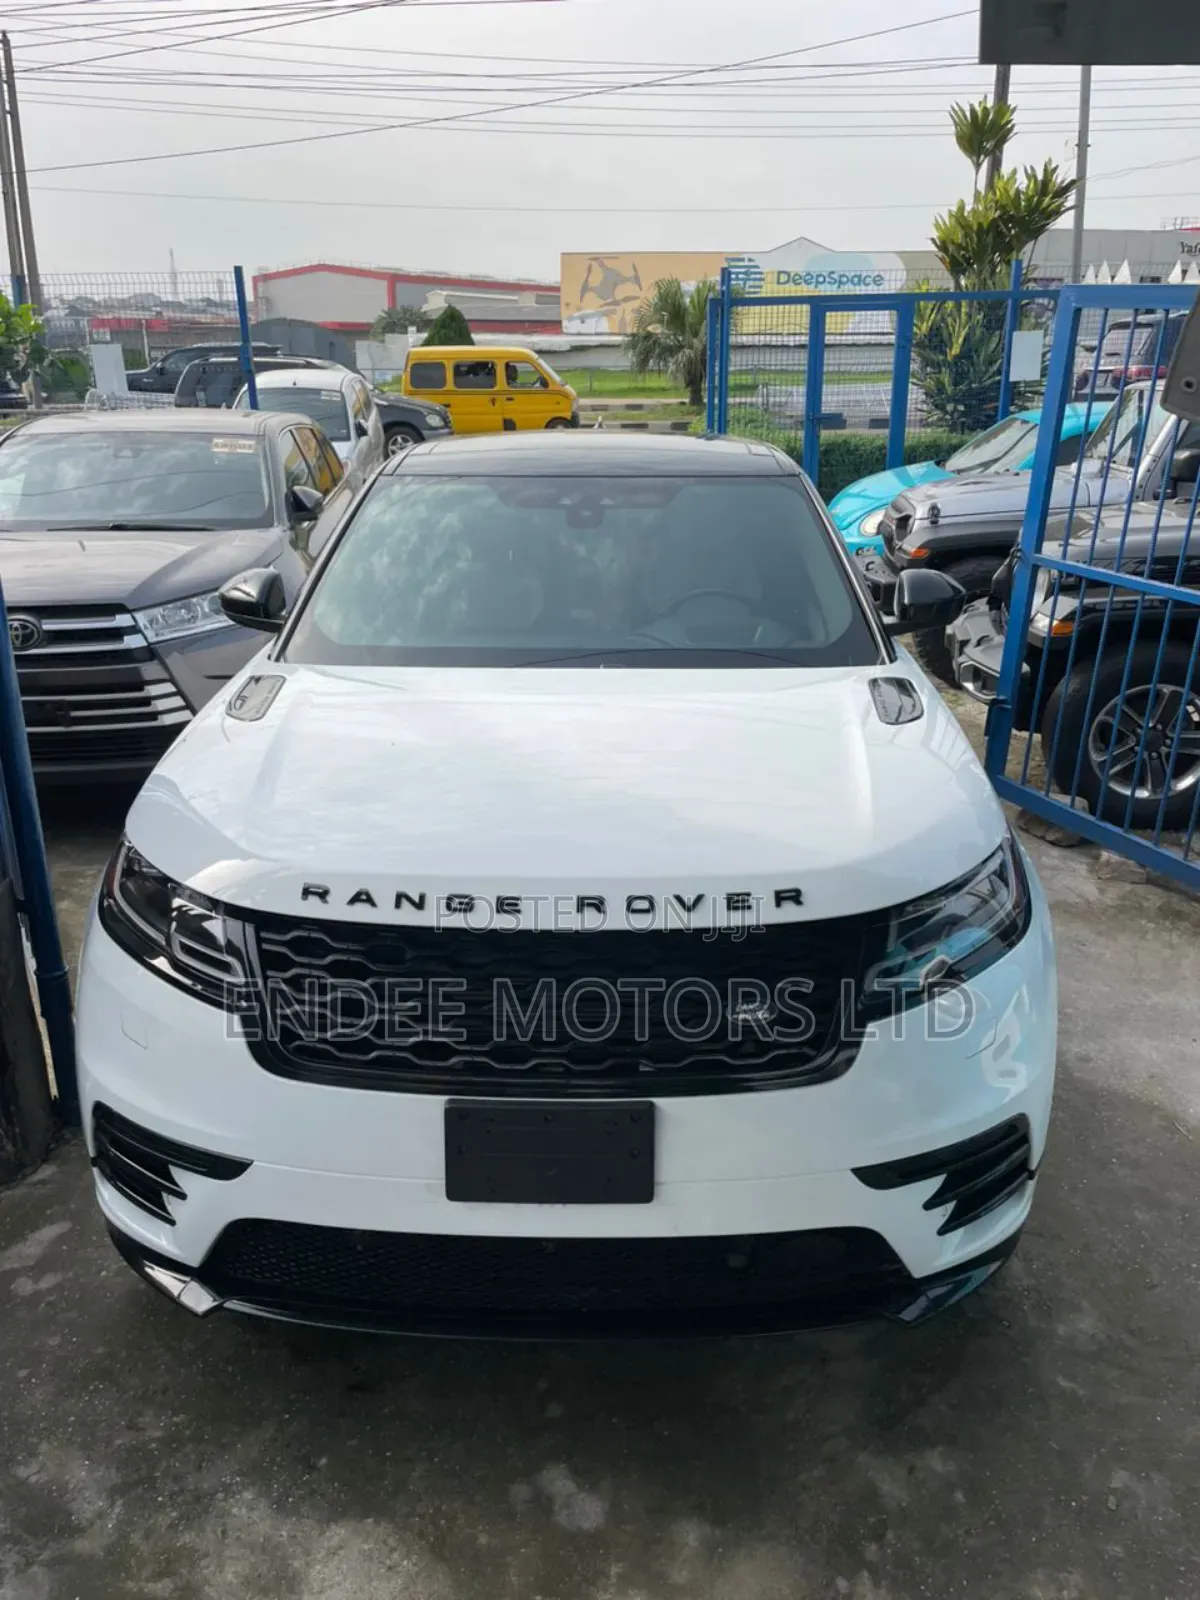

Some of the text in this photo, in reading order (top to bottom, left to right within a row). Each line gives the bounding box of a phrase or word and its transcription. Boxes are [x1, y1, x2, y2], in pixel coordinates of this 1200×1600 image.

[776, 270, 885, 288] DeepSpace
[301, 882, 804, 915] RANGE ROVER
